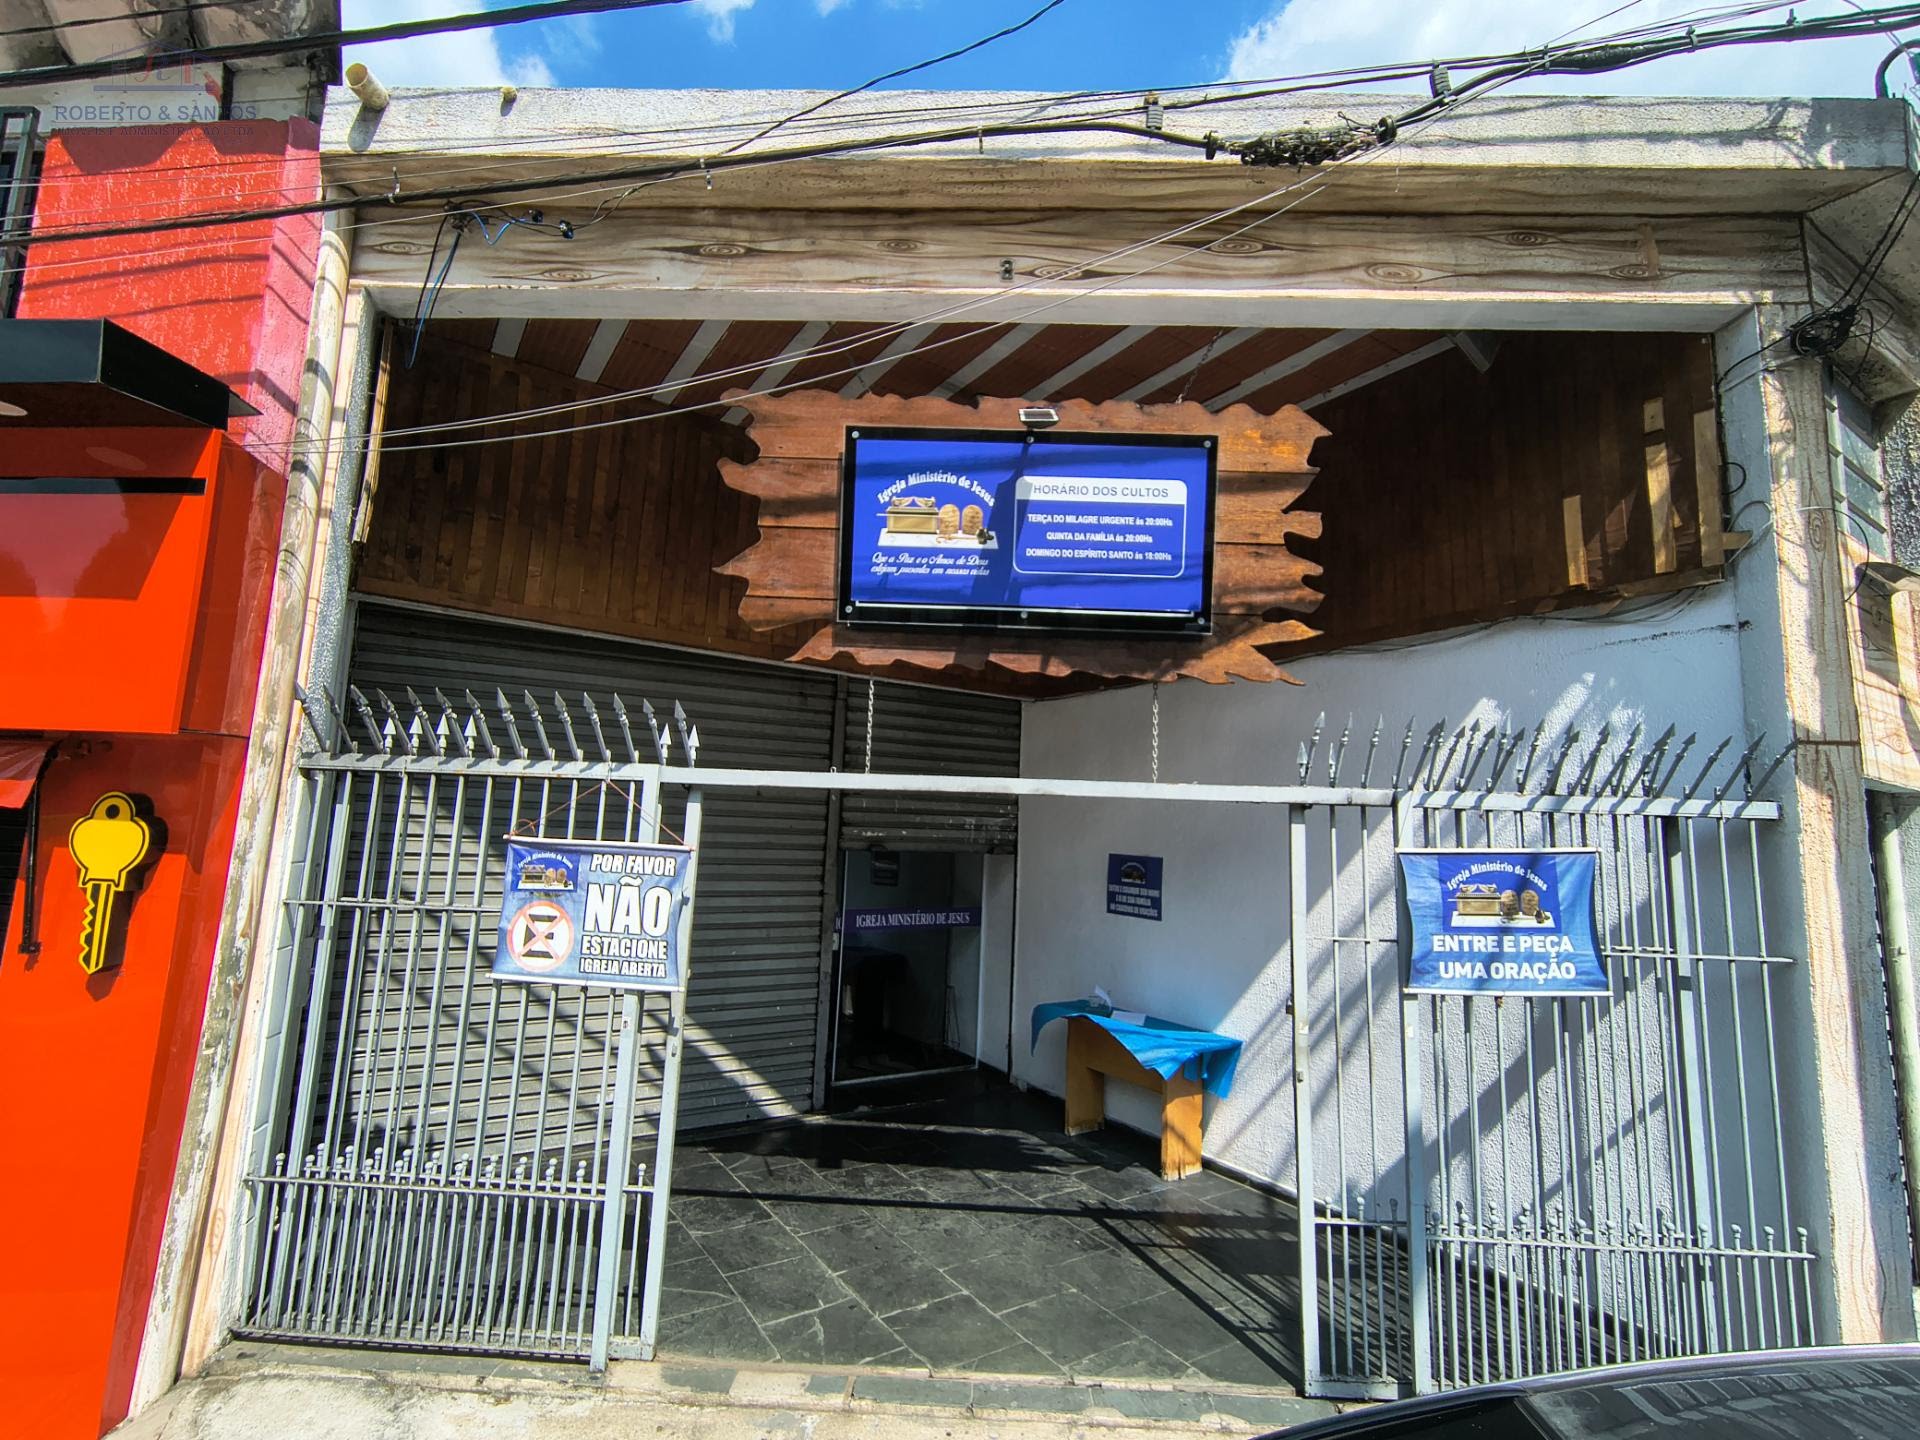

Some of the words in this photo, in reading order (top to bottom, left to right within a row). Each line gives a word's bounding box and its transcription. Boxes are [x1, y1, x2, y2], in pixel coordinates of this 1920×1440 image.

[877, 480, 906, 504] Igreja
[907, 470, 957, 486] Ministério
[958, 476, 971, 488] de
[971, 481, 995, 507] Jesus
[1033, 484, 1089, 496] HORÁRIO
[1092, 486, 1118, 497] DOS
[1121, 487, 1169, 498] CULTOS
[1027, 514, 1052, 525] TERÇA
[1053, 515, 1065, 523] DO
[1066, 515, 1099, 524] MILAGRE
[1100, 516, 1135, 525] URGENTE
[1046, 531, 1073, 541] QUINTA
[1074, 532, 1086, 541] DA
[1086, 531, 1115, 542] FAMÍLIA
[1026, 548, 1061, 558] DOMINGO
[1062, 549, 1073, 558] DO
[1074, 548, 1107, 559] ESPÍRITO
[1108, 550, 1134, 560] SANTO
[589, 853, 624, 874] POR
[624, 854, 677, 877] FAVOR
[1446, 869, 1470, 891] Igreja
[1470, 860, 1513, 875] Ministério
[1514, 864, 1525, 876] de
[1526, 869, 1548, 891] Jesus
[583, 875, 673, 938] NÃO
[856, 914, 886, 928] IGREJA
[887, 909, 935, 926] MINISTÉRIO
[936, 912, 947, 924] DE
[947, 912, 970, 924] JESUS
[580, 934, 668, 960] ESTACIONE
[1432, 935, 1500, 953] ENTRE
[1503, 935, 1516, 953] E
[1518, 935, 1574, 960] PEÇA
[579, 957, 621, 975] IGREJA
[621, 960, 667, 978] ABERTA
[1439, 961, 1488, 980] UMA
[1490, 958, 1576, 985] ORAÇÃO
